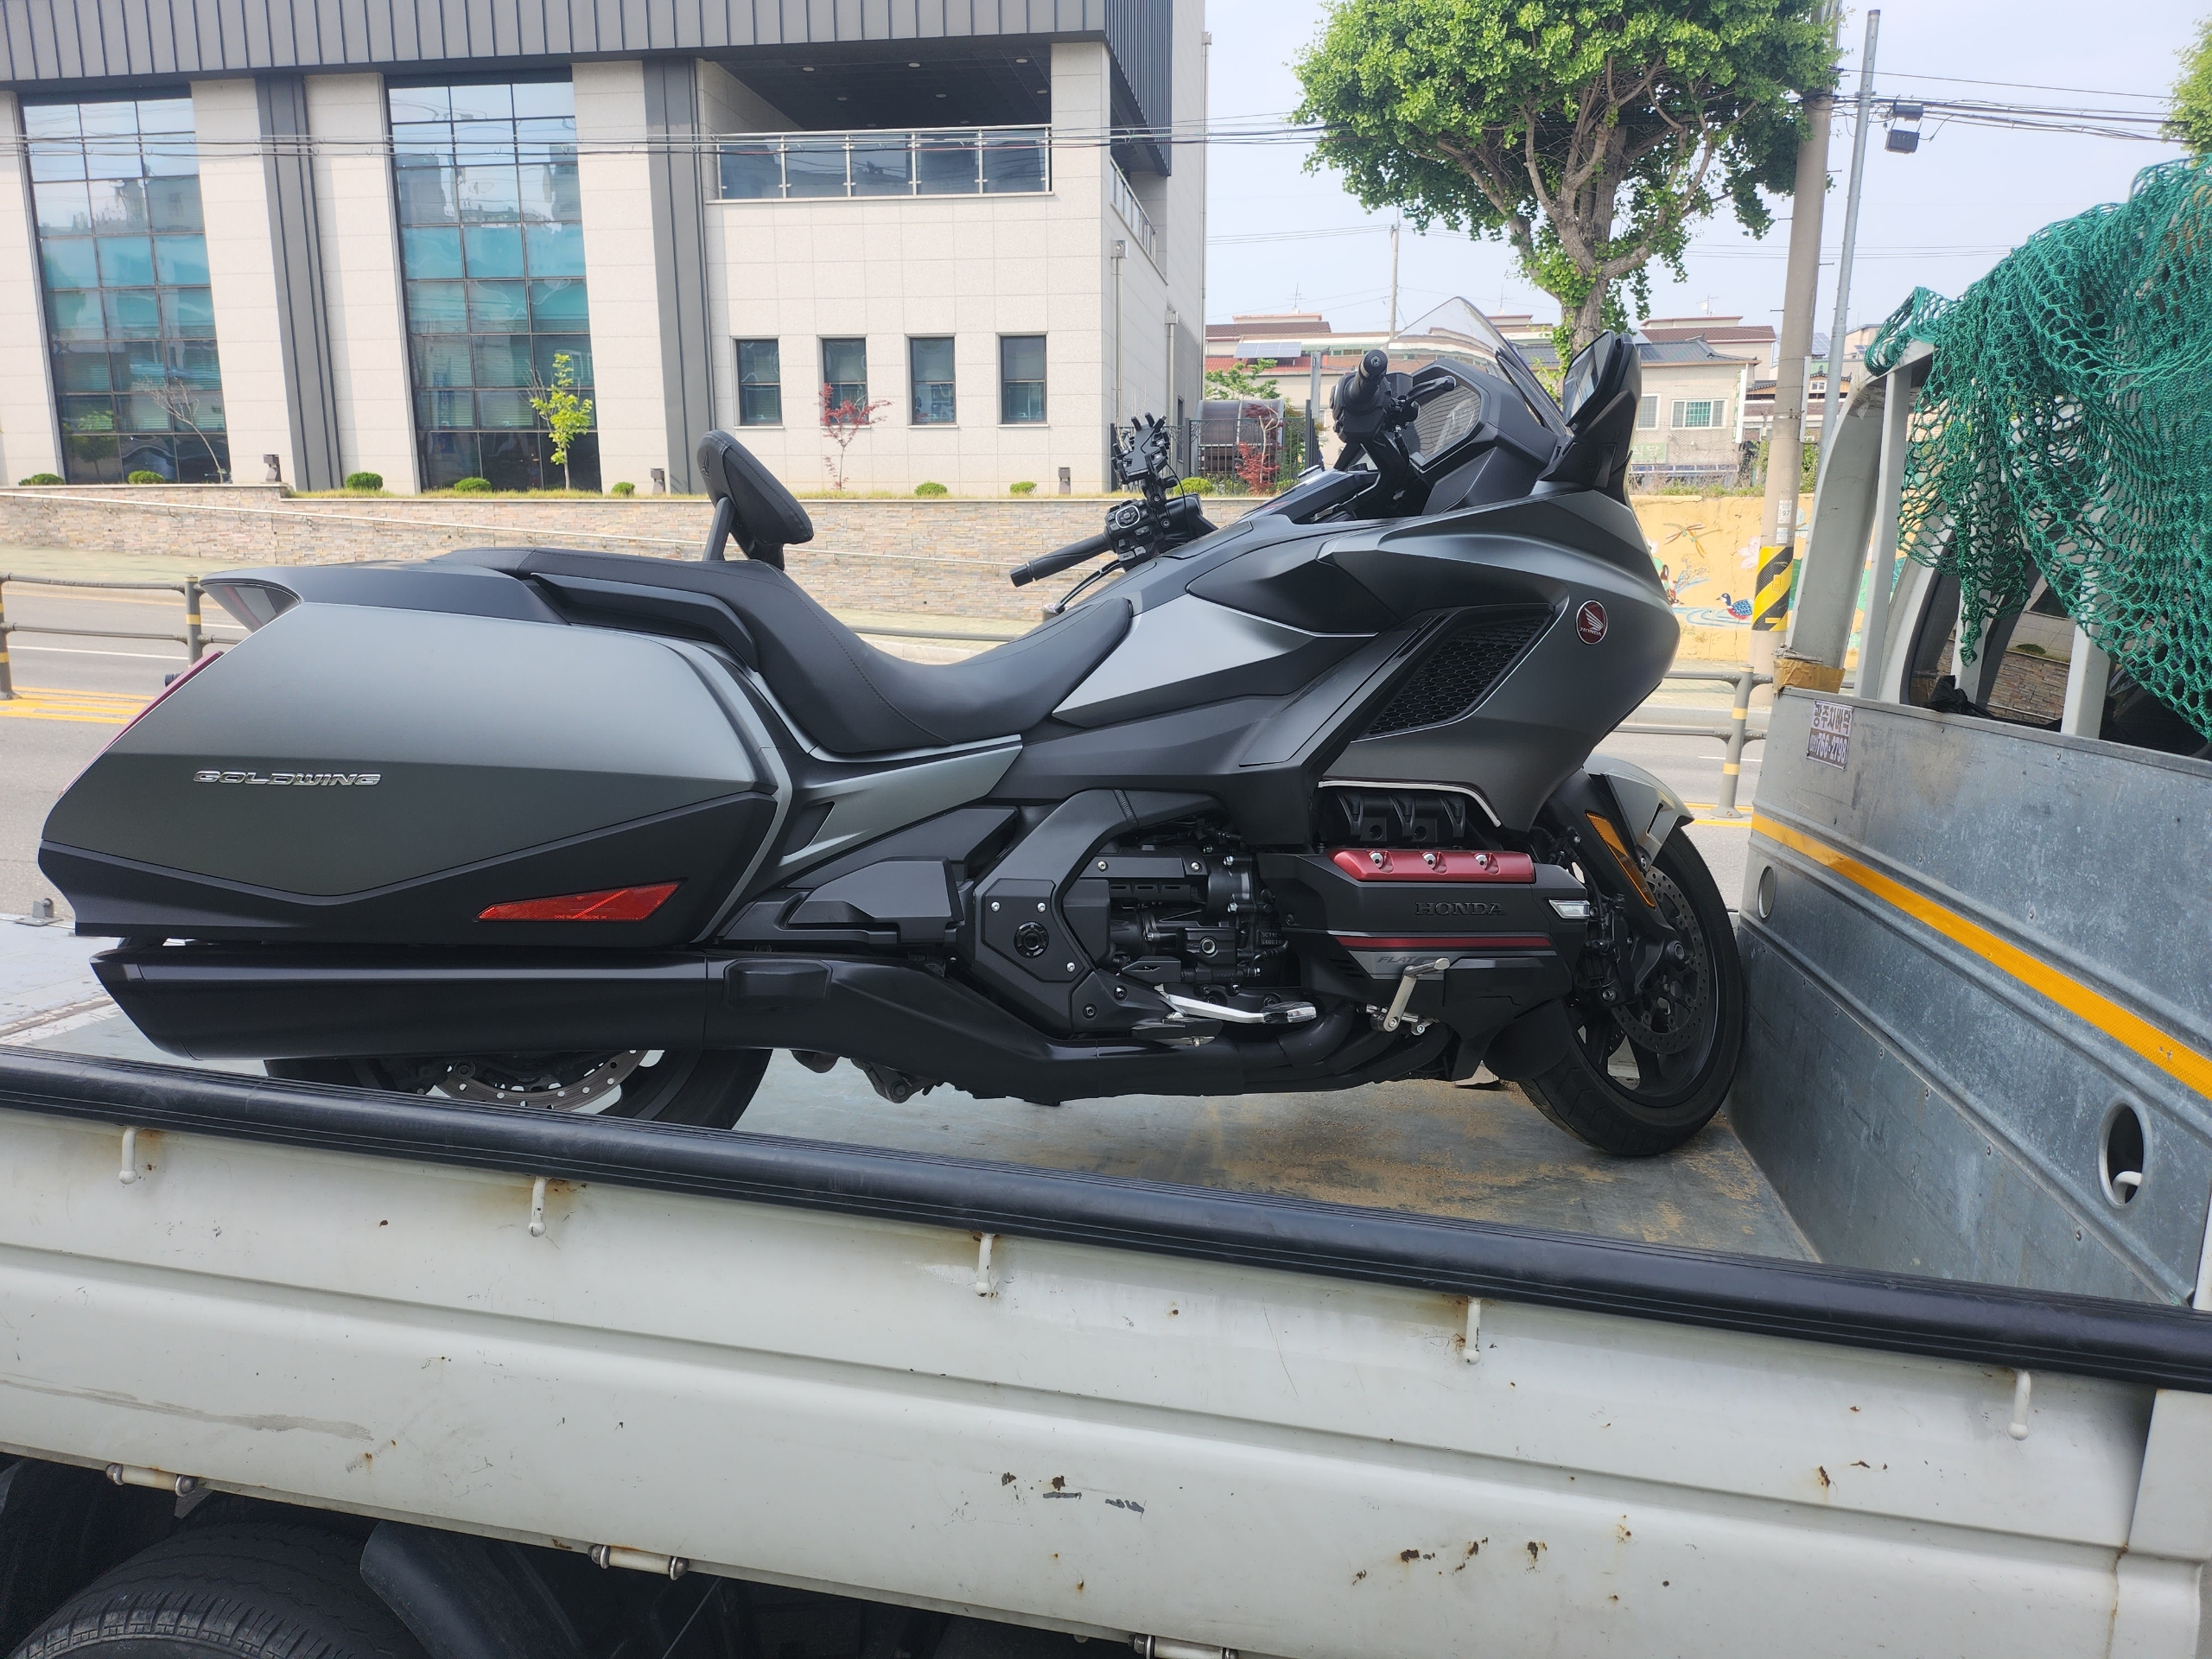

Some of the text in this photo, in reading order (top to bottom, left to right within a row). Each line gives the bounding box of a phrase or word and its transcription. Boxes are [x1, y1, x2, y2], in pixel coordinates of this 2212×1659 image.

[1580, 626, 1602, 637] HONDA
[193, 771, 381, 786] GOLDWING
[1414, 901, 1505, 916] HONDA
